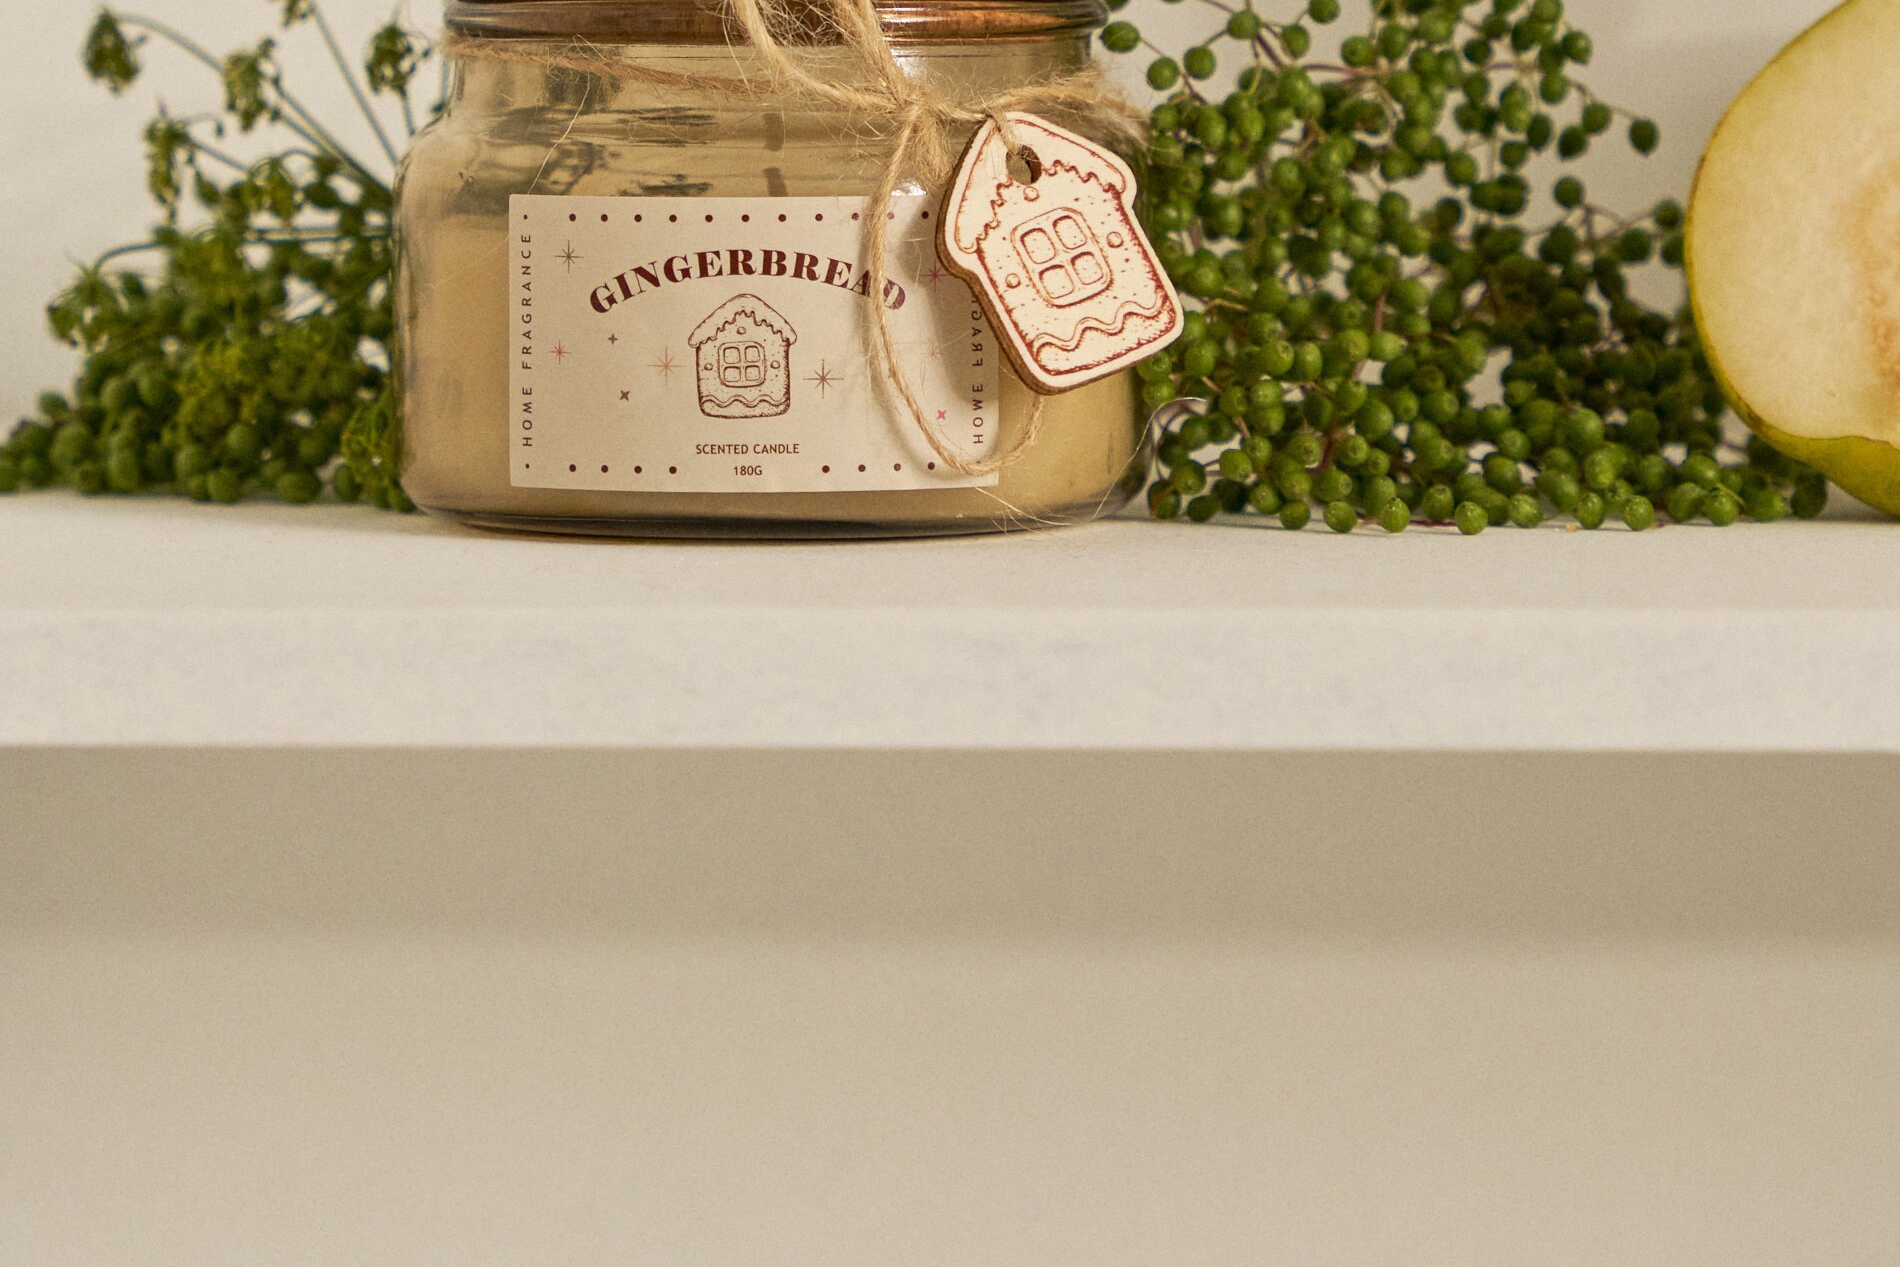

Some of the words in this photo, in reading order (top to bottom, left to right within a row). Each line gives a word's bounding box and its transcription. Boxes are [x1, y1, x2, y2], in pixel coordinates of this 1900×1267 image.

[520, 234, 533, 369] FRAGRANCE
[589, 248, 906, 314] GINGERBREAD
[521, 387, 533, 447] HOME
[695, 443, 749, 455] SCENTED
[753, 443, 800, 455] CANDLE
[733, 465, 763, 476] 180G
